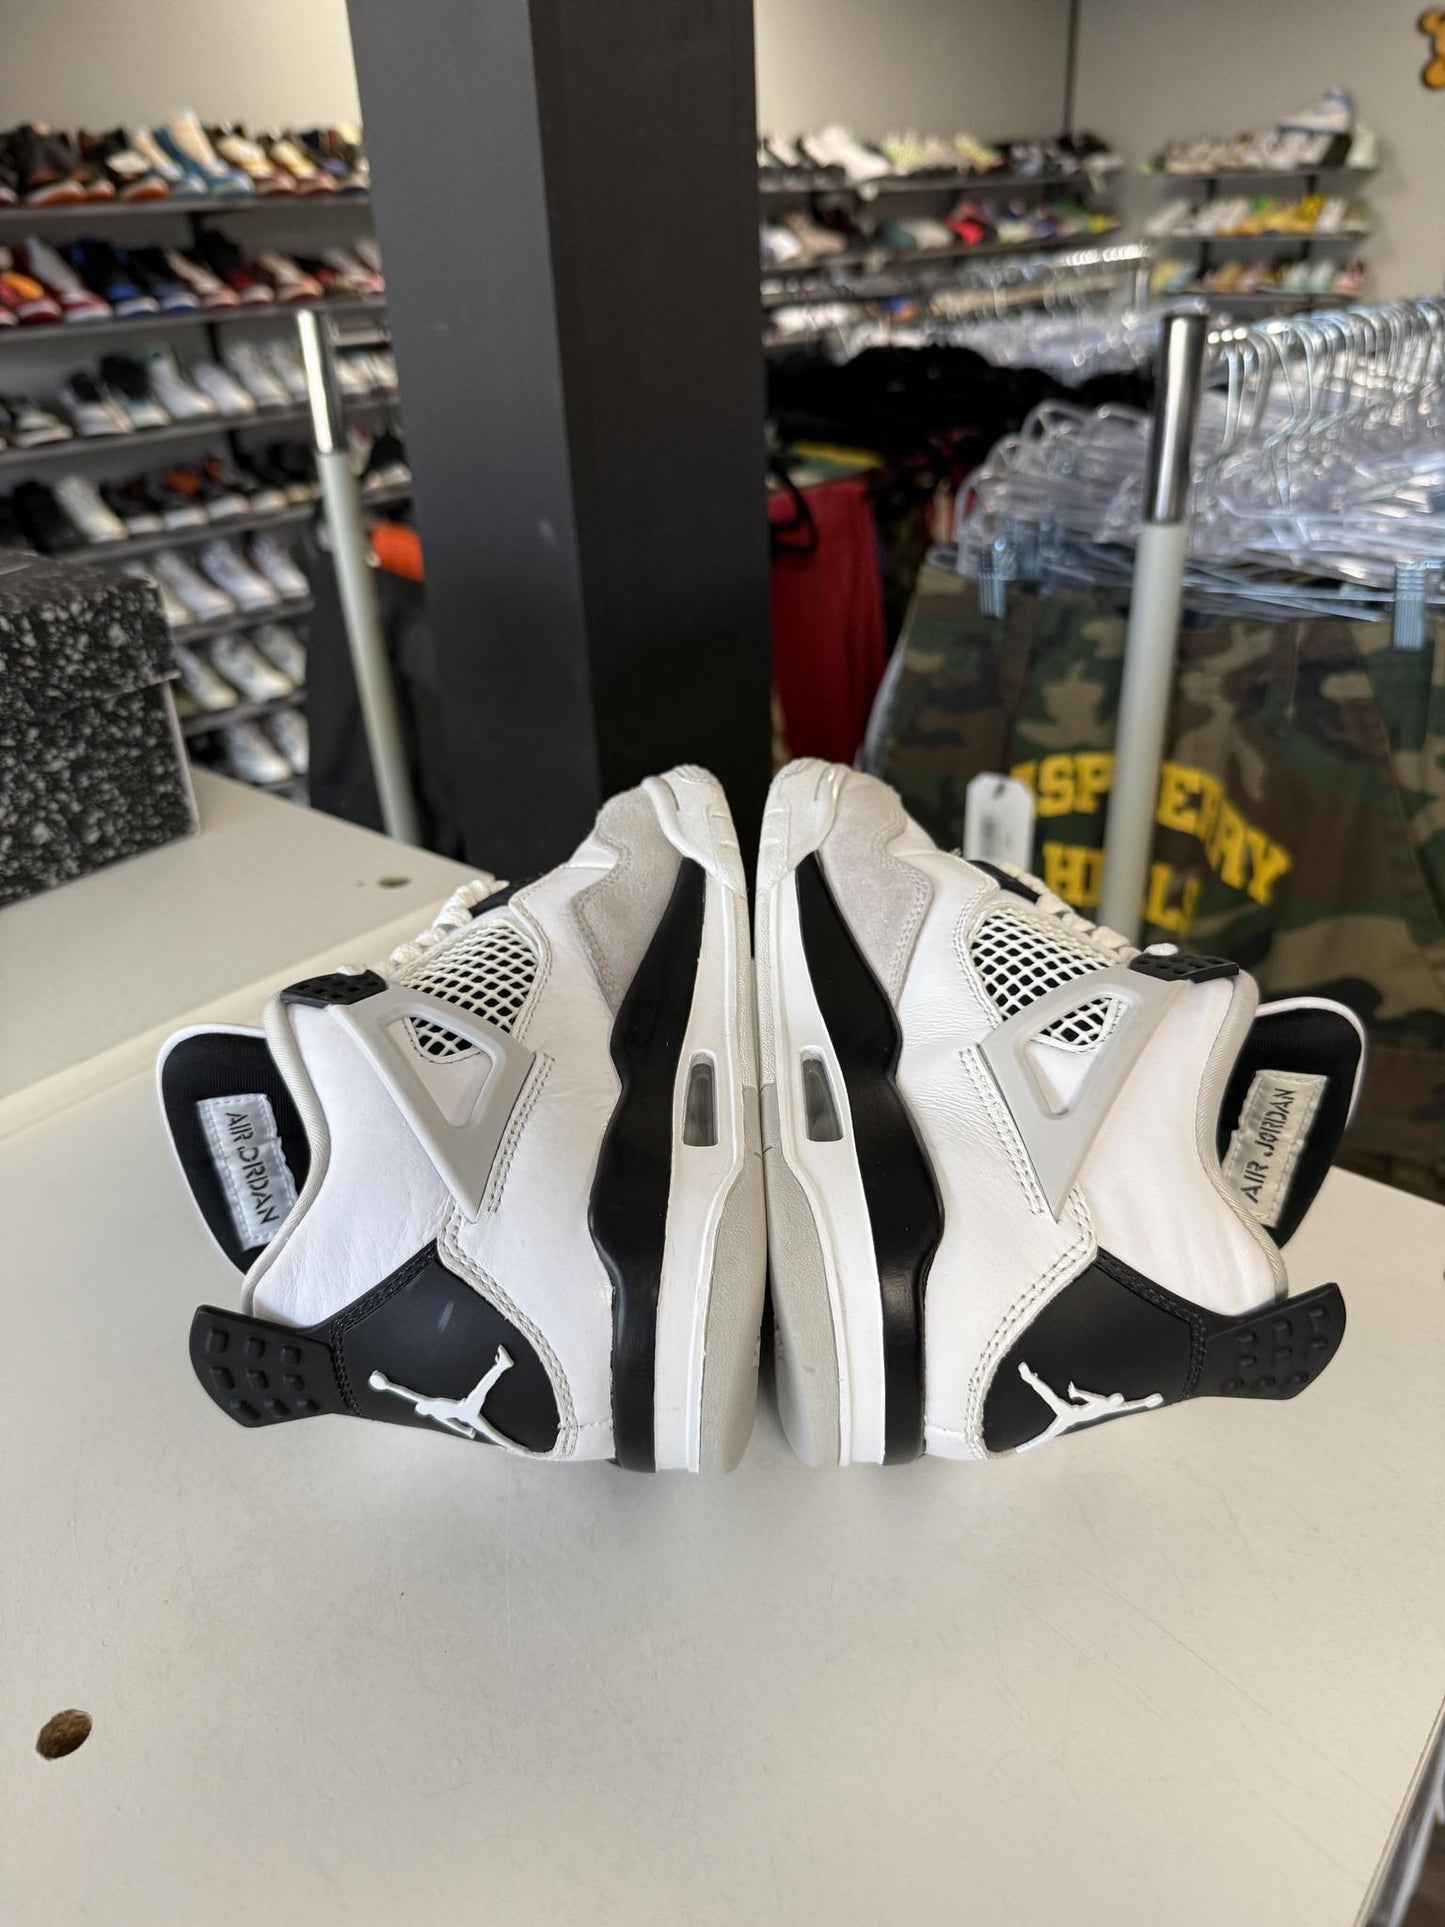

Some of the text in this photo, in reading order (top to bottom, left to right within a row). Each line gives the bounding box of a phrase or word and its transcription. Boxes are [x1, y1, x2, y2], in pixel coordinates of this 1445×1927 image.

[225, 1112, 254, 1142] AIR
[1240, 1088, 1296, 1204] AIR JORDAN
